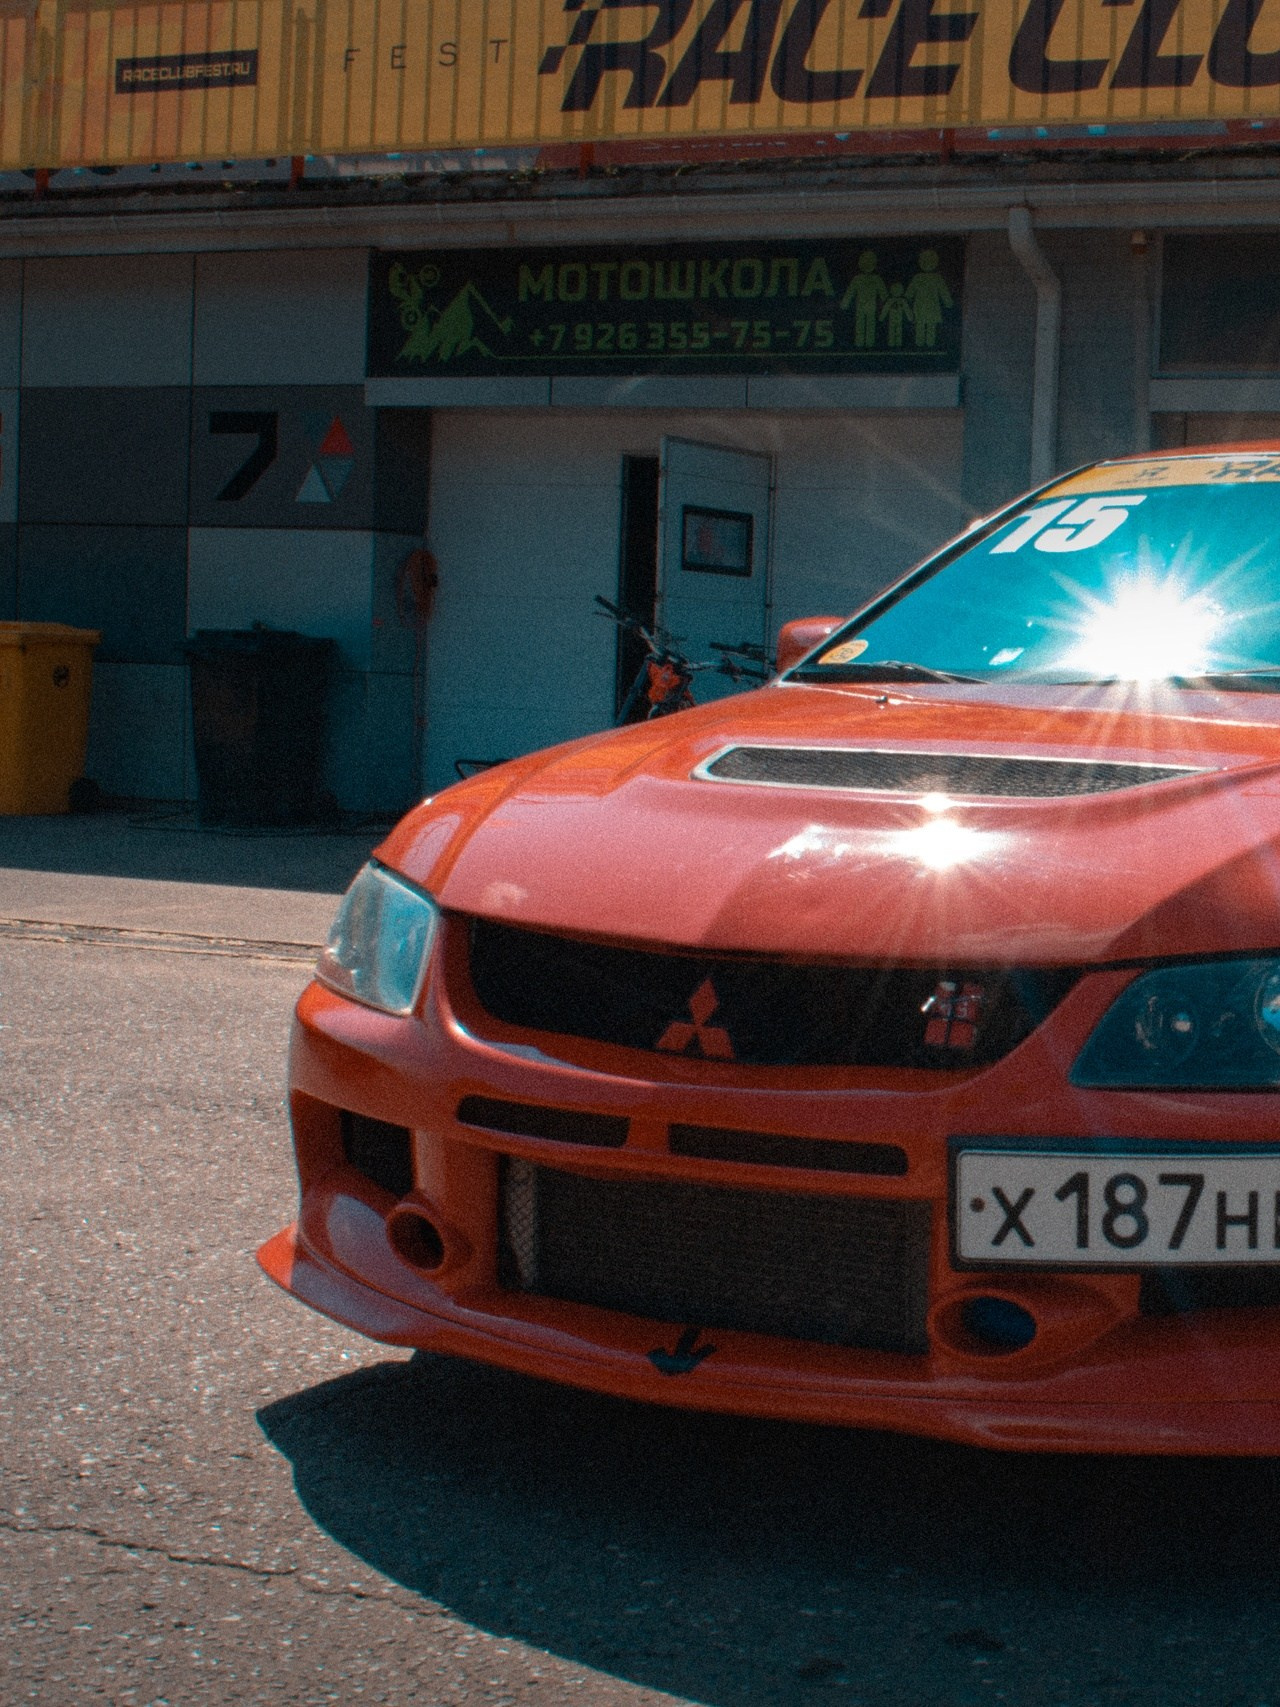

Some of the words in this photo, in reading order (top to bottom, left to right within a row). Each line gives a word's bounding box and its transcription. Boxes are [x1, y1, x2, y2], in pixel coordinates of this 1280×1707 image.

[121, 61, 252, 83] RACECLUBFEST.RU
[343, 38, 509, 73] FEST
[537, 0, 981, 111] RACE
[517, 257, 836, 301] МОТОШКОЛА
[208, 411, 279, 501] 7
[987, 493, 1148, 555] 15
